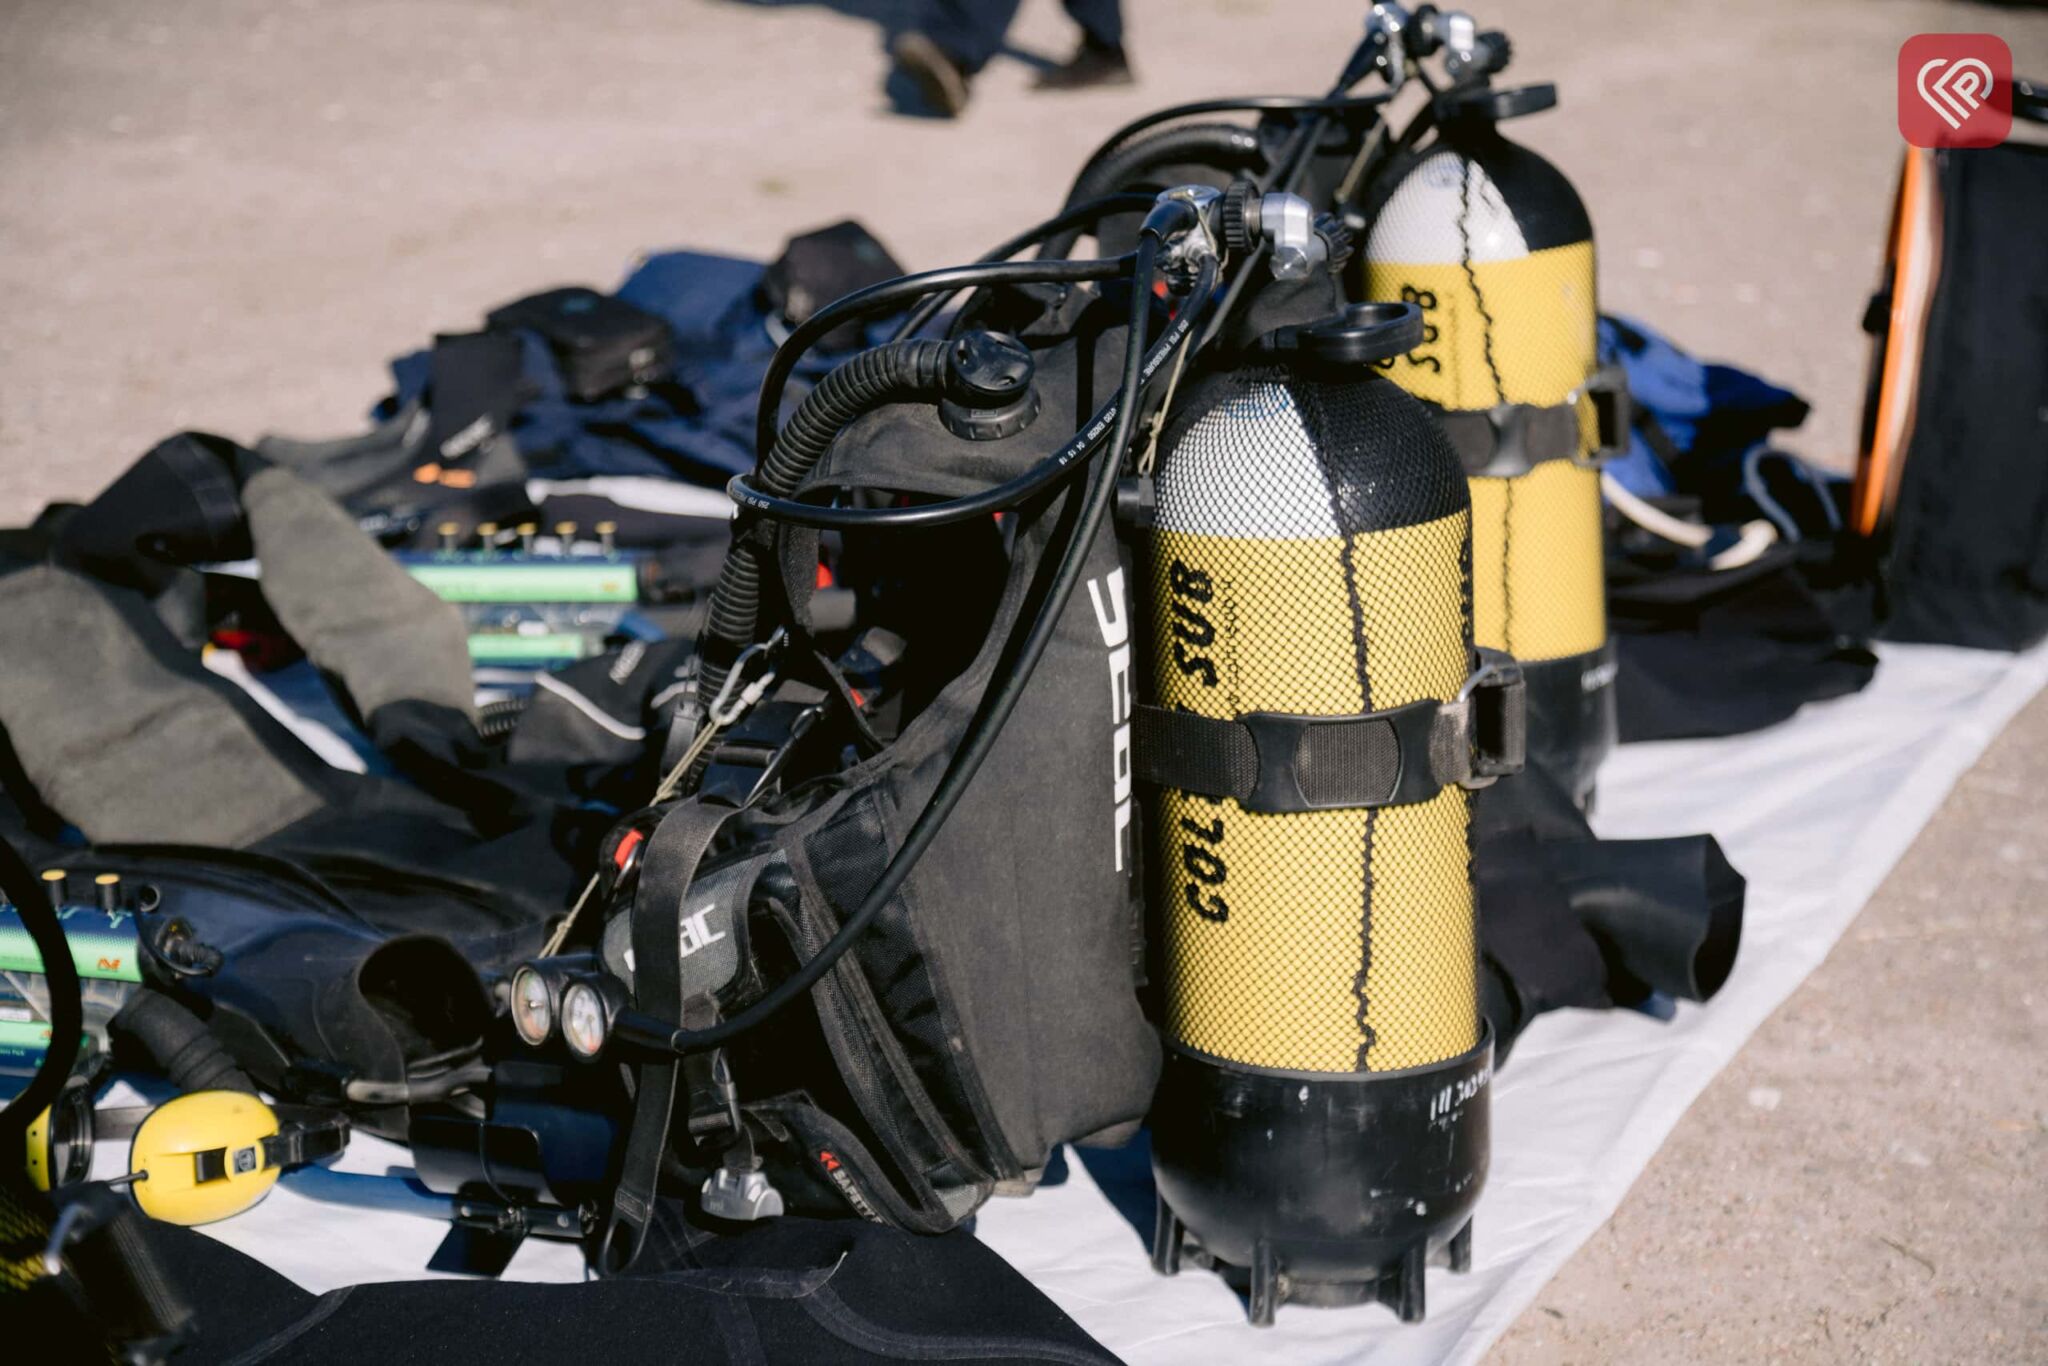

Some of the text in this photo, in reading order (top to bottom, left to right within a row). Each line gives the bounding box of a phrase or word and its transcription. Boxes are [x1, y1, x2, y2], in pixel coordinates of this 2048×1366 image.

[1143, 343, 1171, 377] PRESSURE
[1170, 559, 1217, 688] SUB
[833, 1168, 876, 1216] SAFETY
